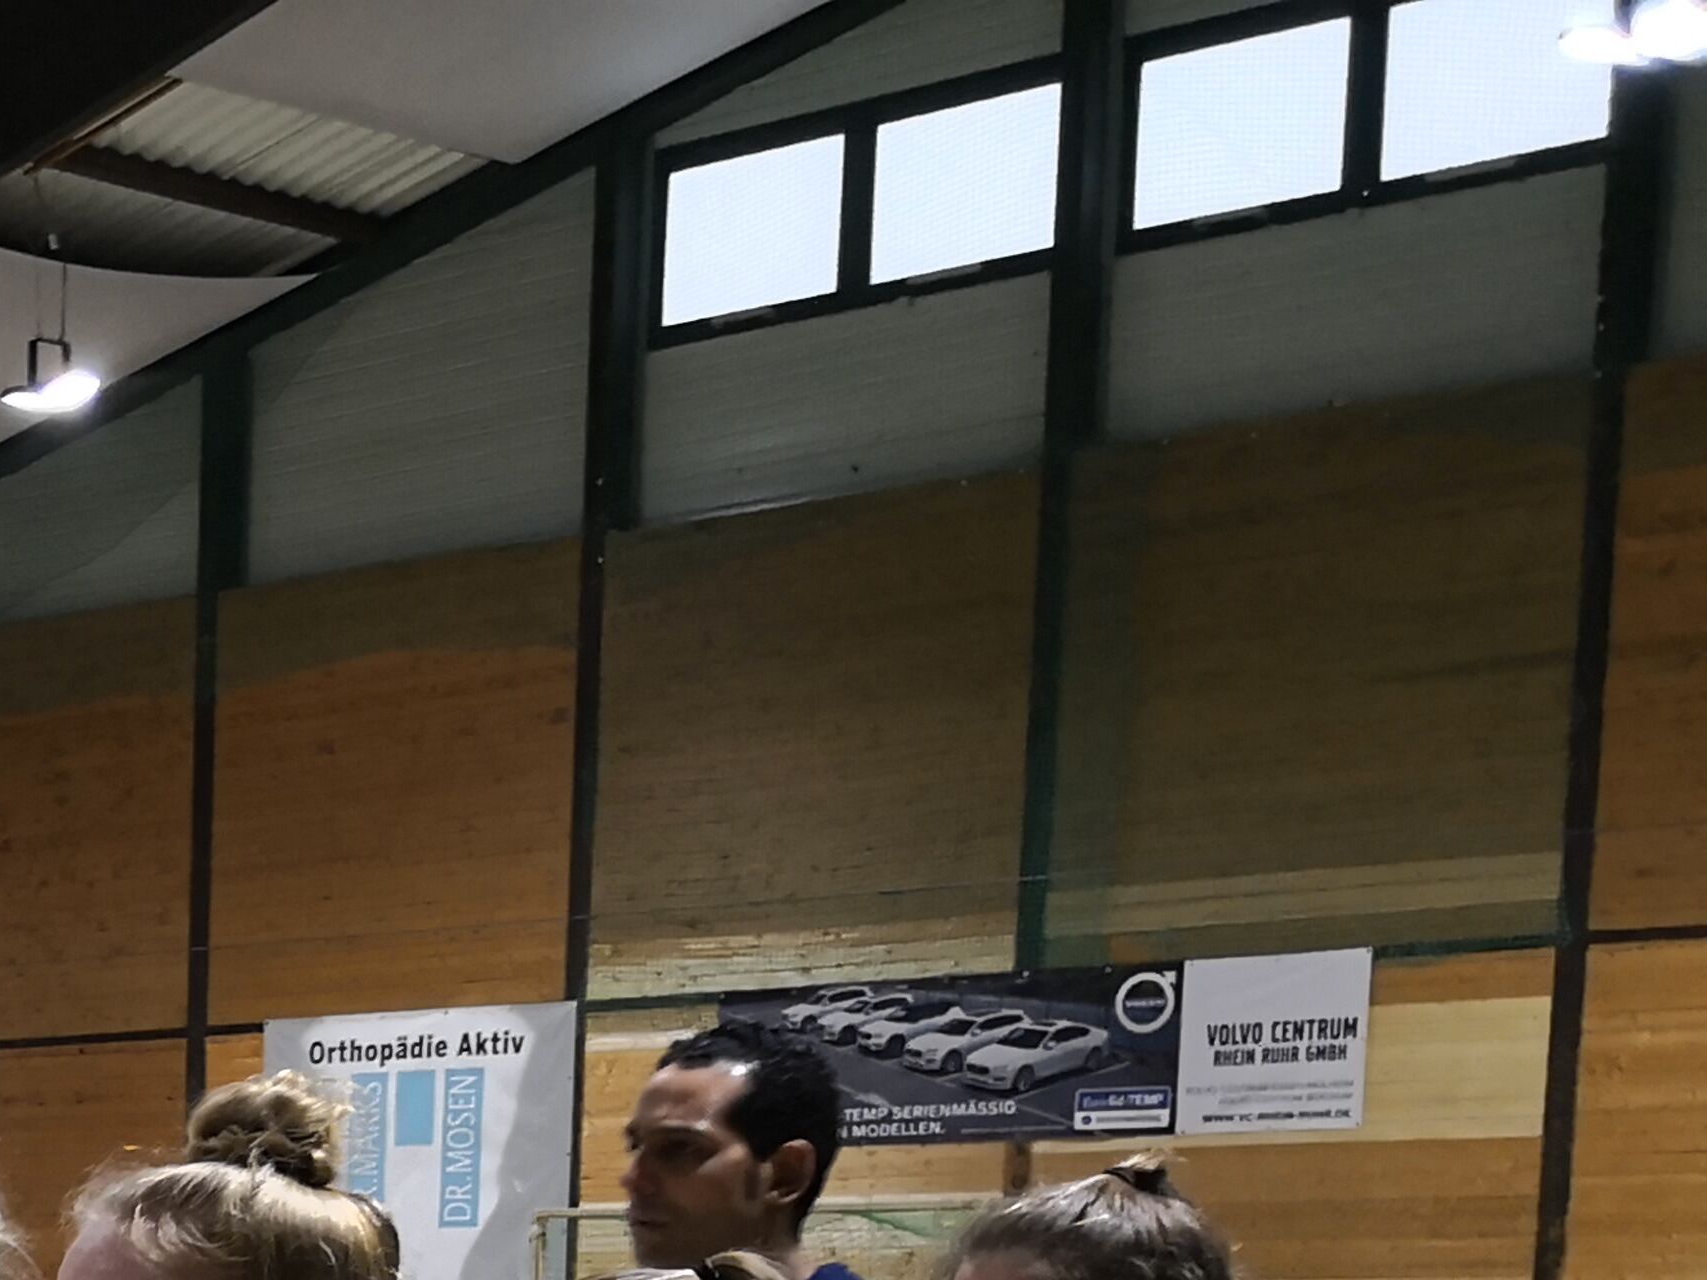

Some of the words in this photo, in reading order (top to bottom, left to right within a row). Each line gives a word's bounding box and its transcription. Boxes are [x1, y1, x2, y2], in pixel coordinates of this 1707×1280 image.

[309, 1033, 448, 1067] Orthopädie
[457, 1029, 525, 1057] Aktiv
[1206, 1021, 1263, 1047] VOLVO
[1271, 1016, 1359, 1044] CENTRUM
[1213, 1048, 1256, 1067] RHEIN
[1261, 1046, 1300, 1065] RUHR
[1305, 1043, 1348, 1063] GMBH
[843, 1106, 889, 1122] TEMP
[351, 1080, 383, 1196] R.MARKS
[442, 1075, 478, 1222] DR.MOSEN
